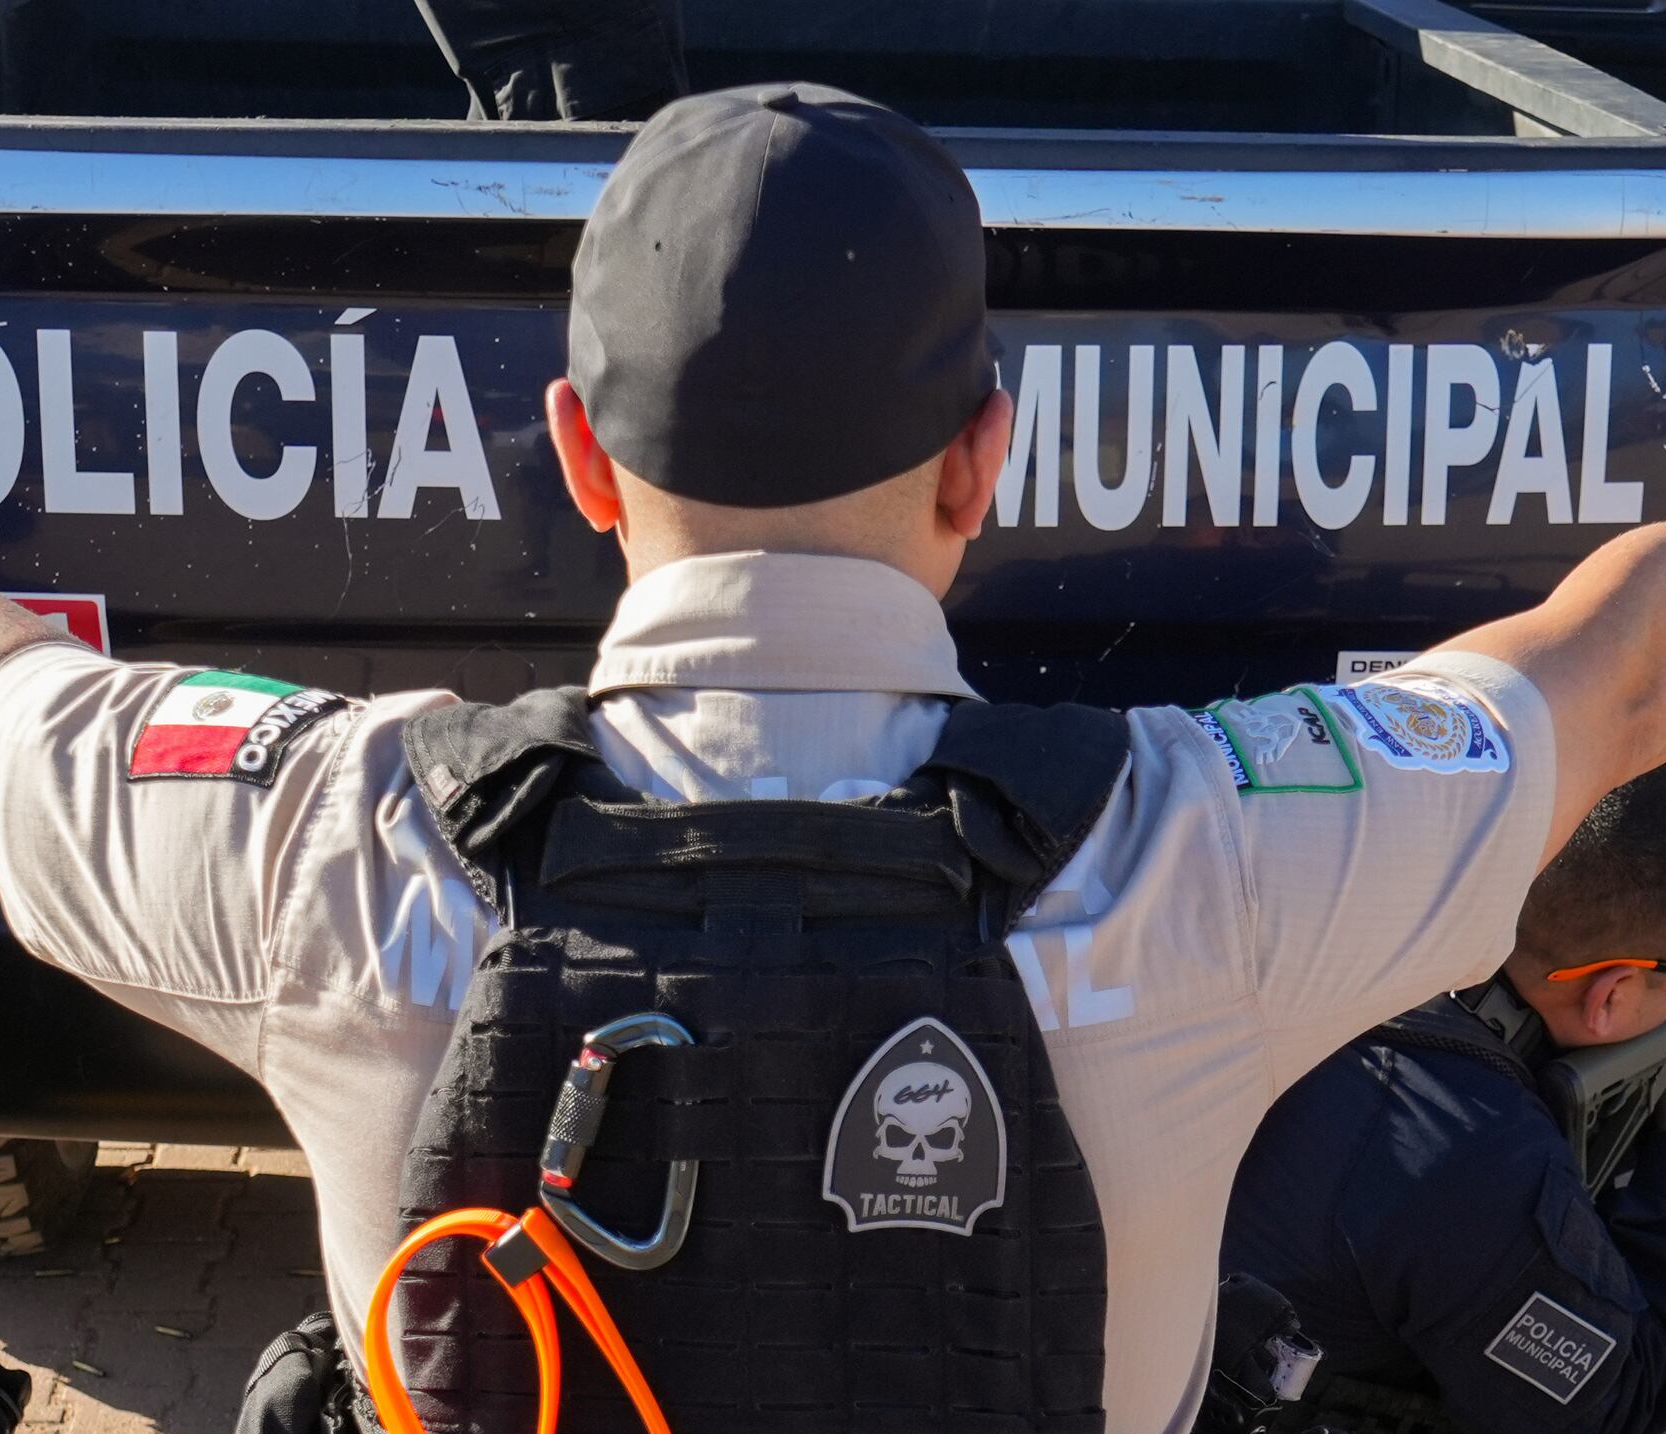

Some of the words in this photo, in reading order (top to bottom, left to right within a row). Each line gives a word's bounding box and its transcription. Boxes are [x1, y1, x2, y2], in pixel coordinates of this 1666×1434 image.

[993, 341, 1644, 531] MUNICIPAL
[1351, 660, 1409, 673] DEN
[860, 1193, 965, 1221] TACTICAL
[1505, 1330, 1582, 1385] MUNICIPAL
[1516, 1314, 1593, 1372] POLICÍA
